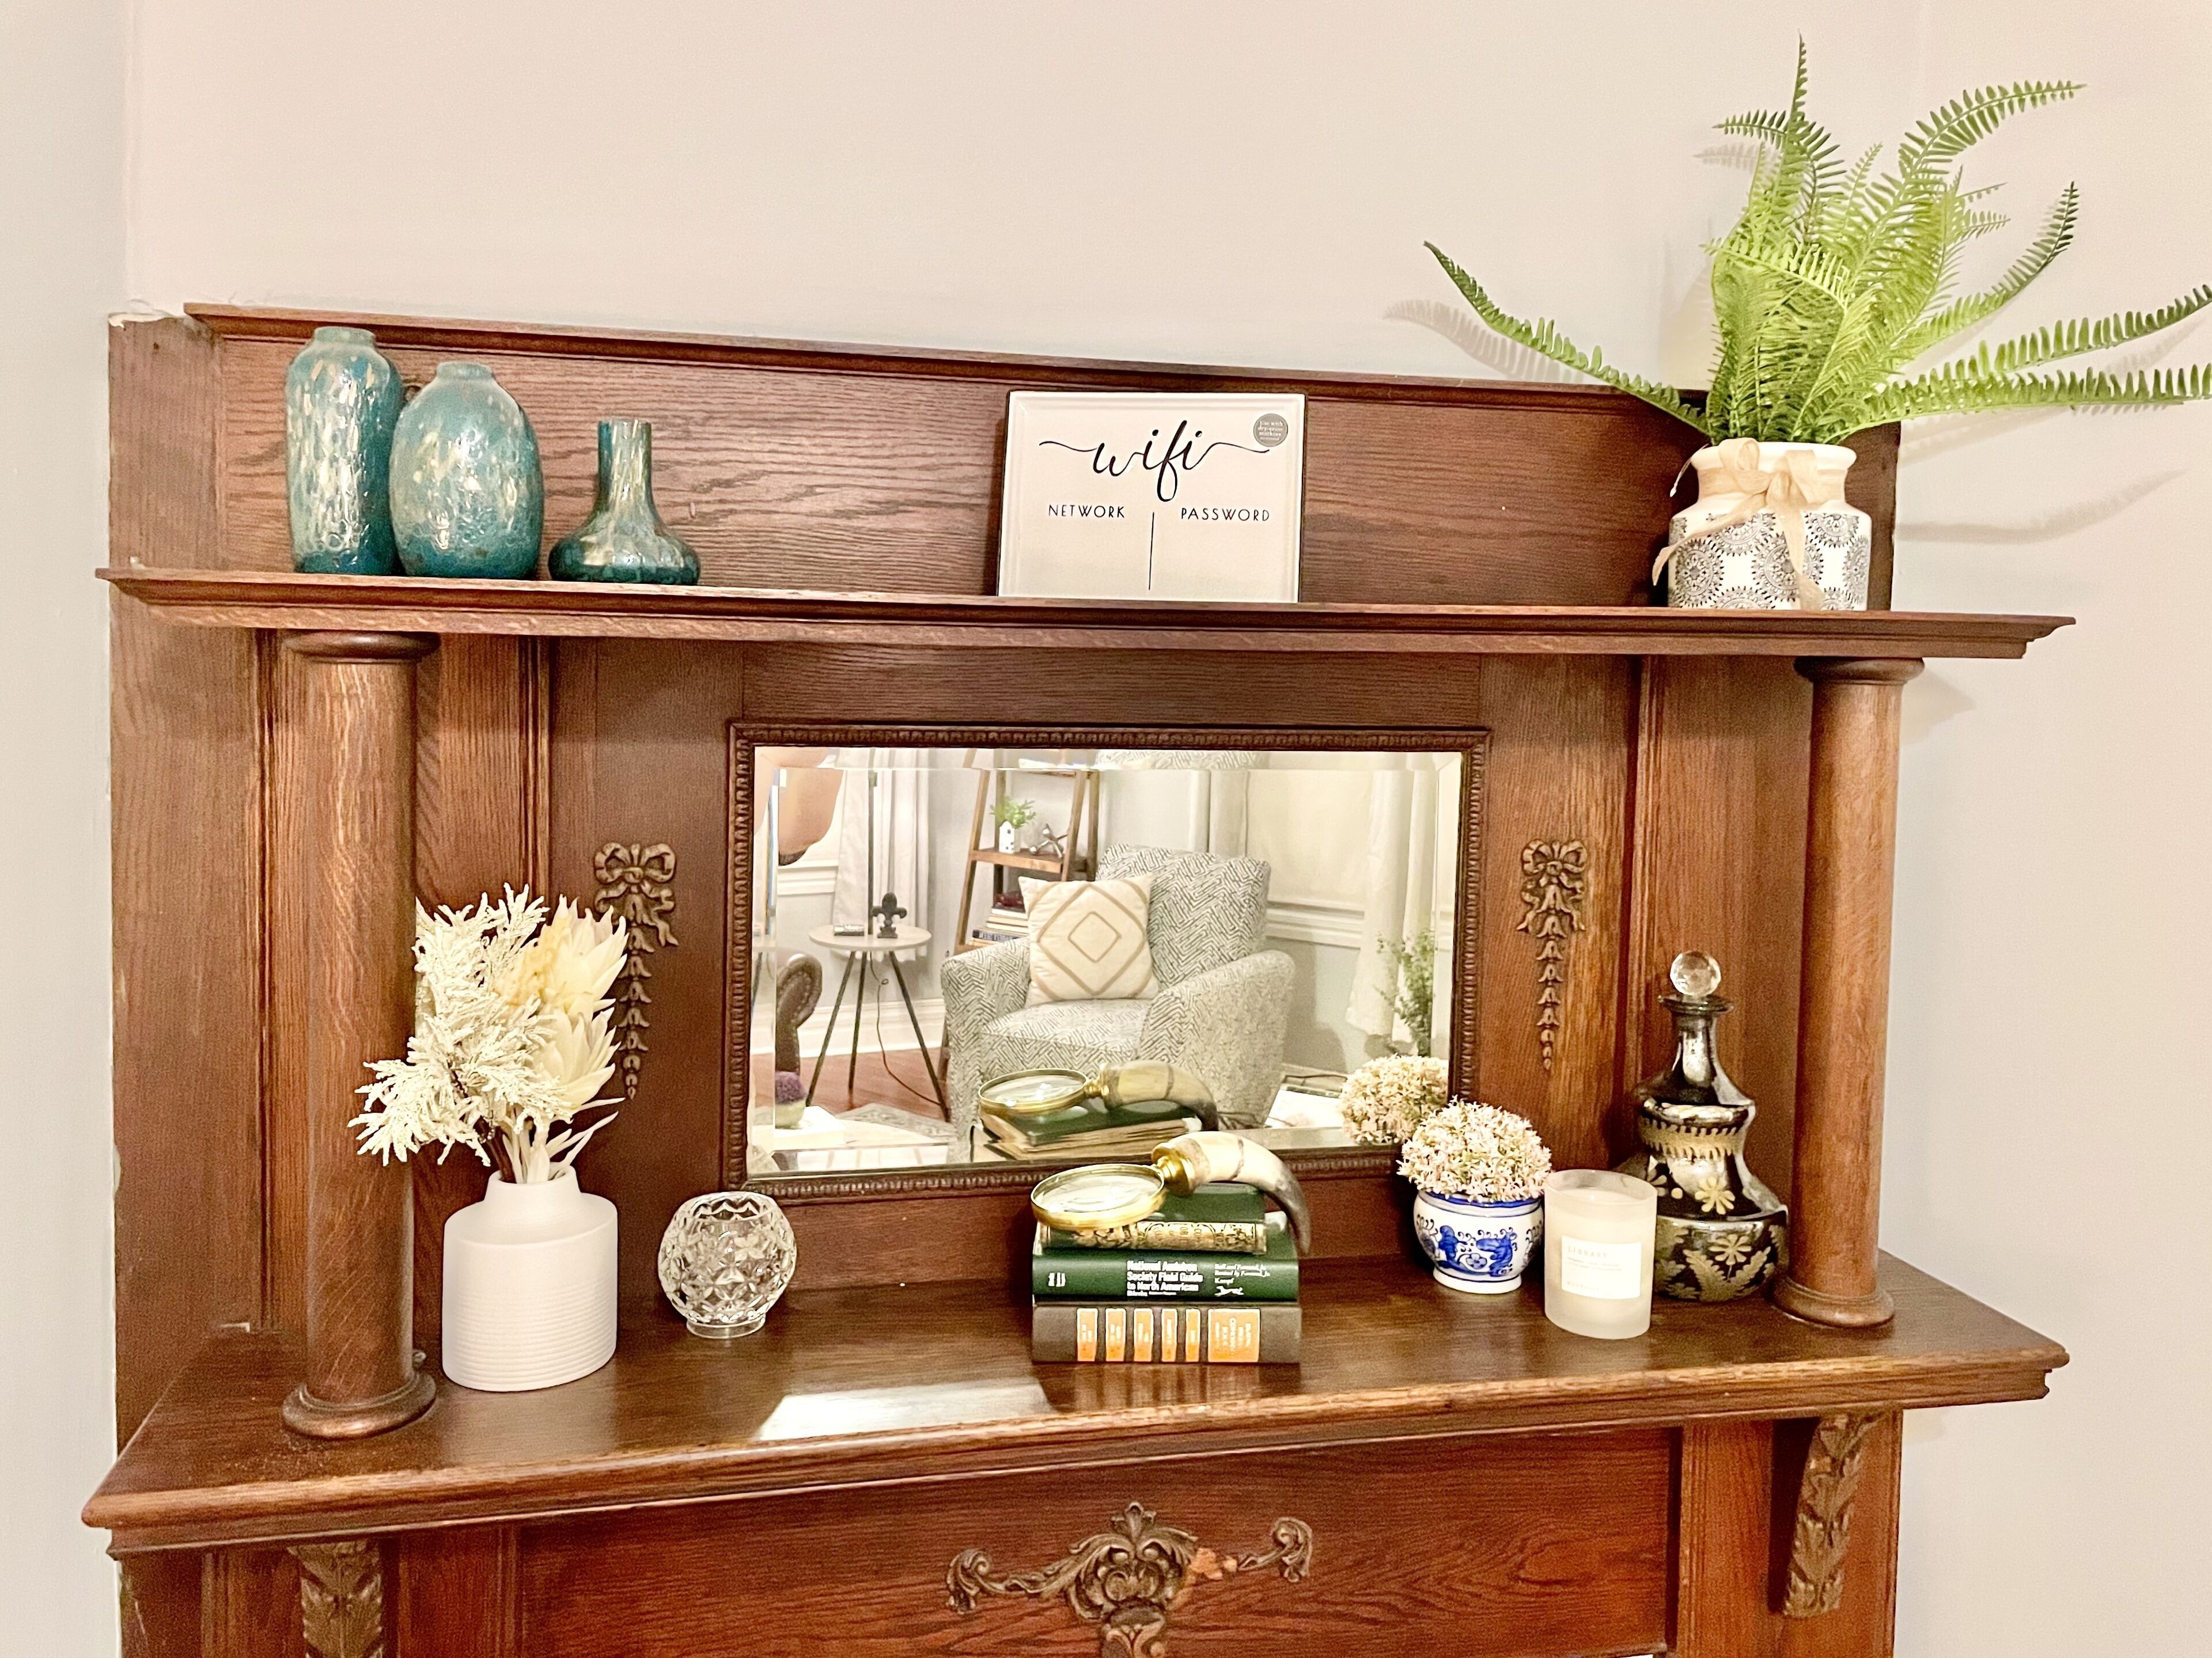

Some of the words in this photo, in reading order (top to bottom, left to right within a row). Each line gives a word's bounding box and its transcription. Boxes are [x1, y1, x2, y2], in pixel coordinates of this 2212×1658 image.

[1048, 504, 1125, 518] NETWORK
[1181, 507, 1270, 521] PASSWORD
[1567, 1246, 1608, 1258] LIBRARY
[1127, 1271, 1158, 1283] Society
[1158, 1272, 1179, 1282] Field
[1127, 1281, 1137, 1290] to
[1137, 1281, 1160, 1291] North
